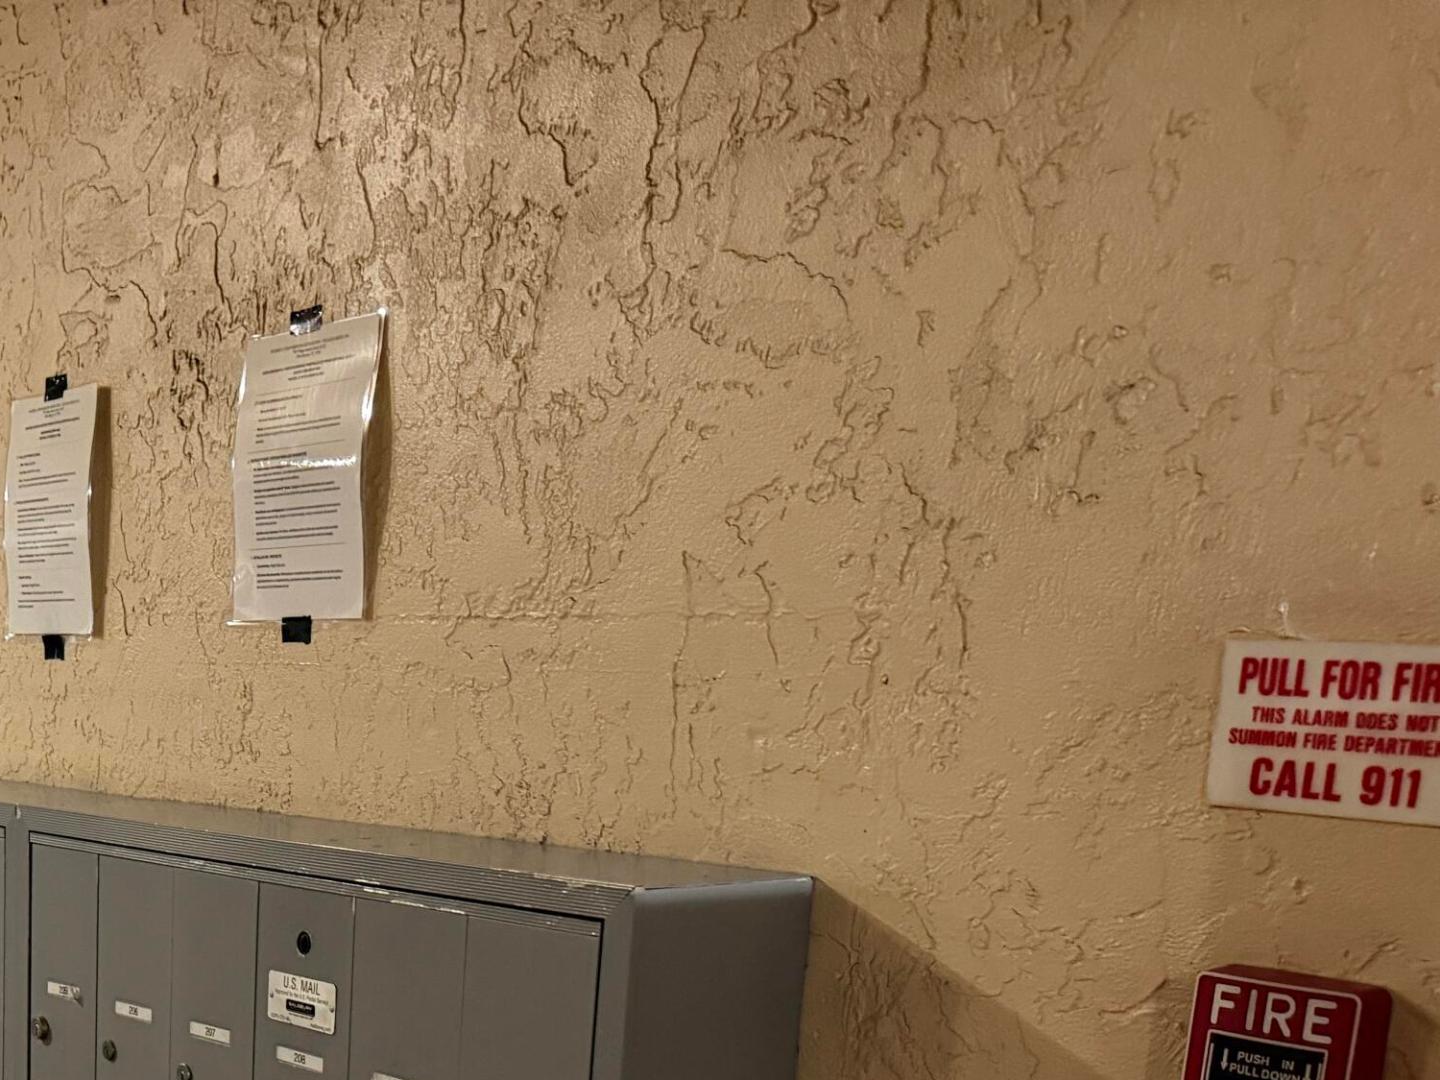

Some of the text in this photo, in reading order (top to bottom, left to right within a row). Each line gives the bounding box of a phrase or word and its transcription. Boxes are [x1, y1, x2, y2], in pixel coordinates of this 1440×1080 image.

[1238, 657, 1440, 704] PULL FOR FIR
[1252, 706, 1440, 733] THIS ALARM DOES NOT
[1228, 727, 1440, 758] SUMMON FIRE DEPARTME
[1248, 756, 1422, 810] CALL 911
[283, 975, 298, 991] U.S.
[300, 980, 321, 997] MAIL
[1210, 983, 1338, 1045] FIRE
[204, 1026, 217, 1038] 207
[1229, 1062, 1260, 1079] PULL
[1237, 1050, 1295, 1071] PUSH IN
